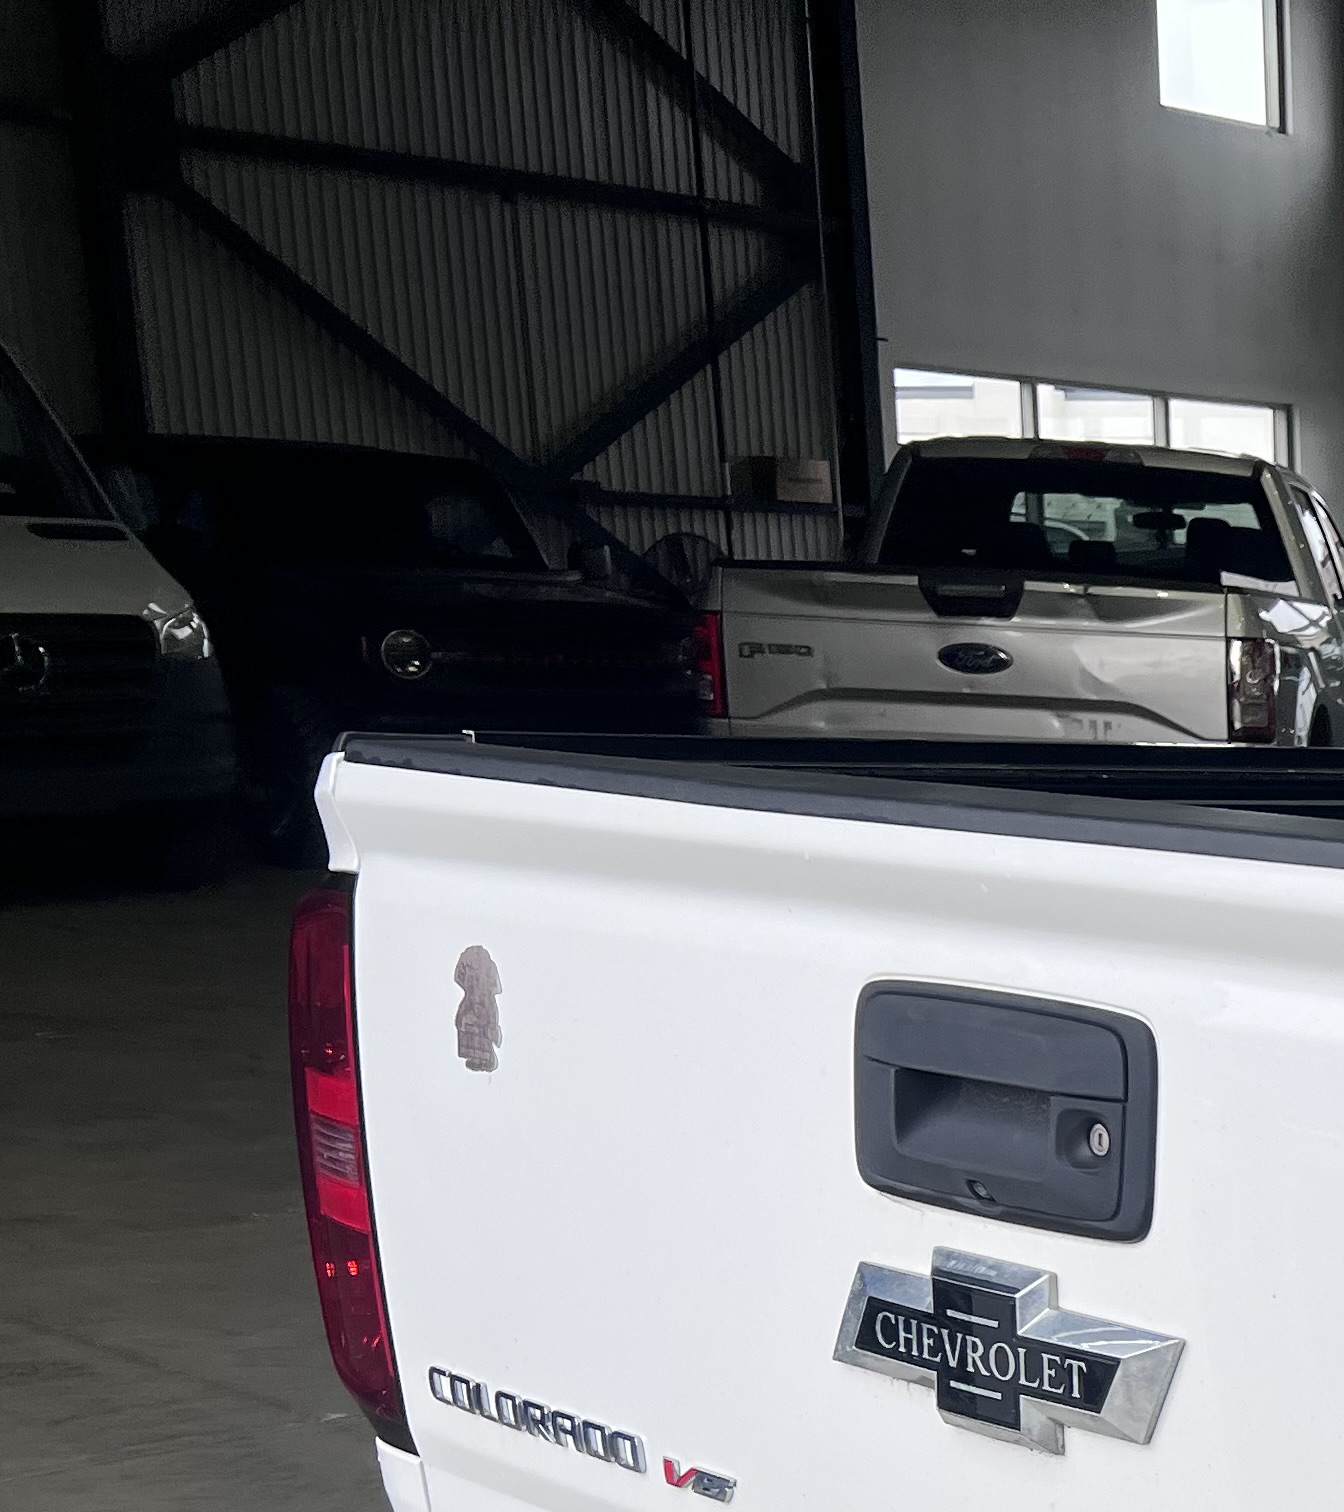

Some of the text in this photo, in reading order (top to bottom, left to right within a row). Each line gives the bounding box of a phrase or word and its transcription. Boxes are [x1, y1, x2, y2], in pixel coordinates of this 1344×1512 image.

[875, 1310, 1088, 1399] CHEVROLET
[428, 1365, 738, 1504] COLORADO V6
